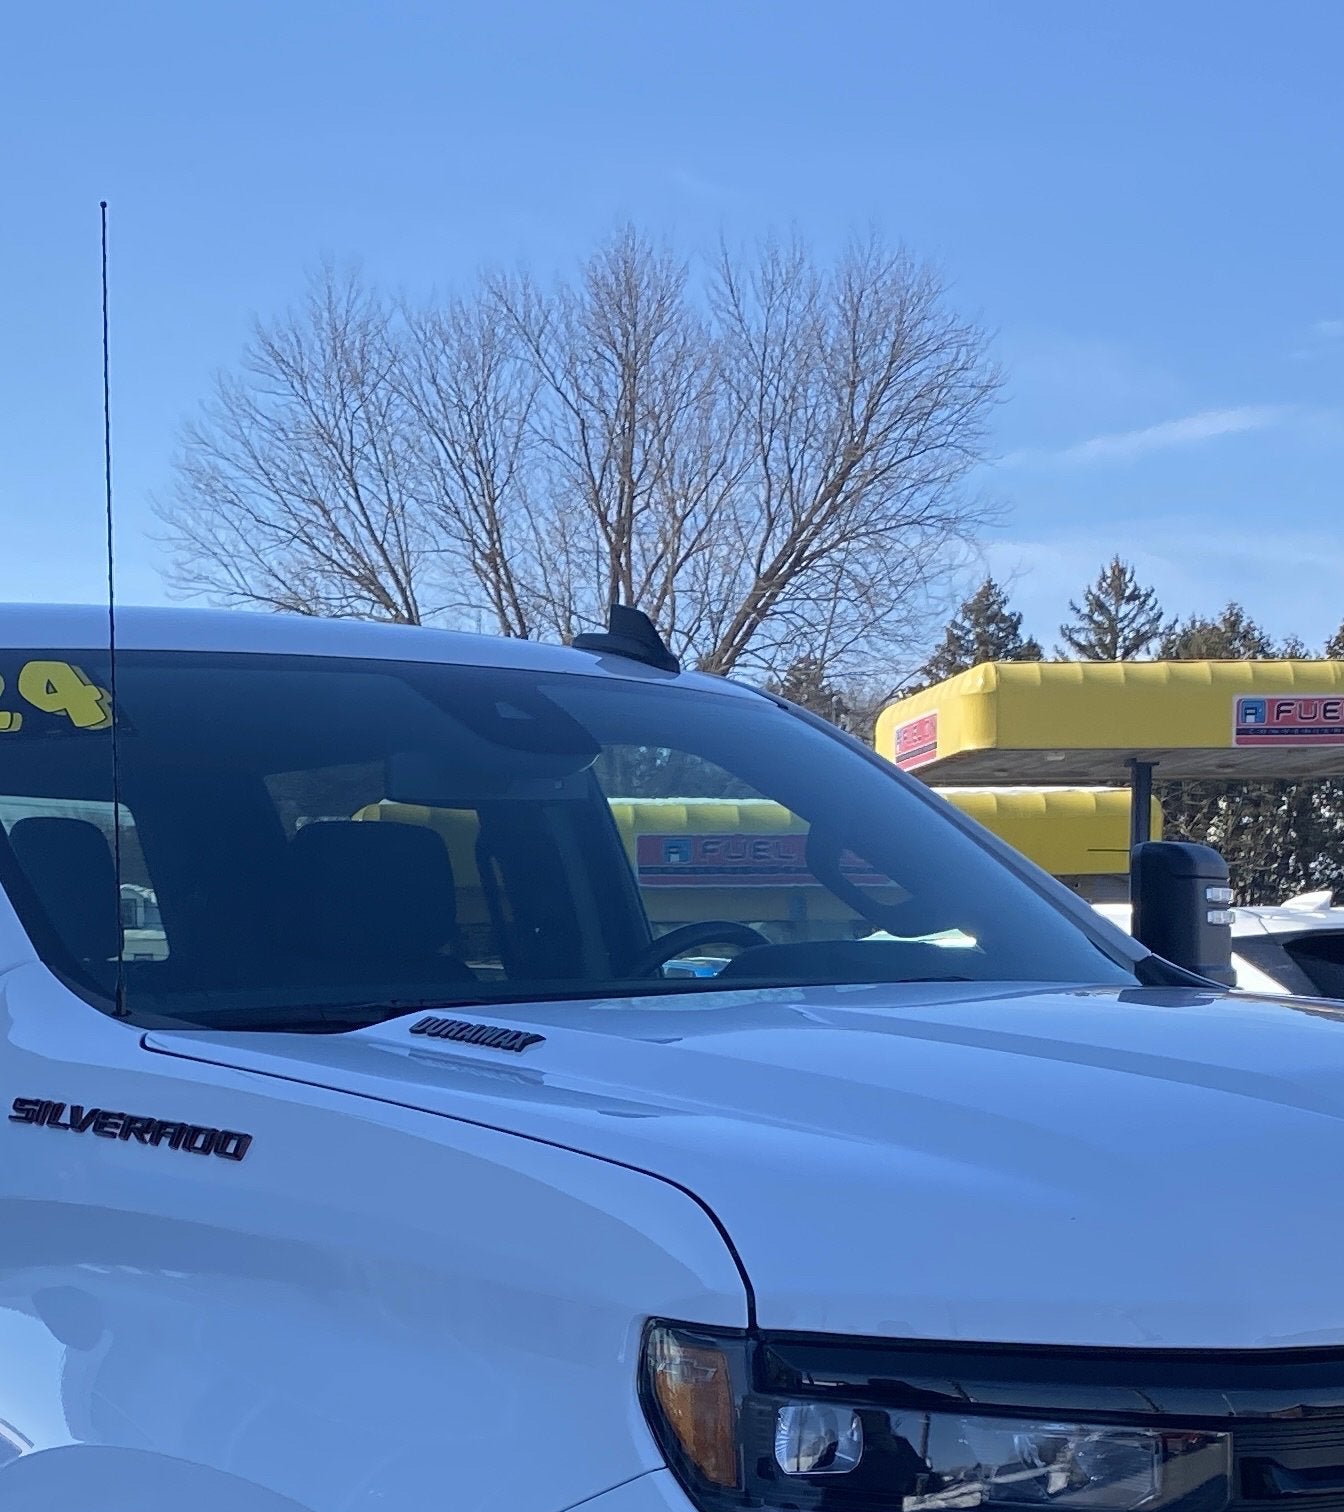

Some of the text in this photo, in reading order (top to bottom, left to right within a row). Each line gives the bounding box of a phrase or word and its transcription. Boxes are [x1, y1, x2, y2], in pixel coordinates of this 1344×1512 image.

[701, 840, 796, 861] FUEL
[409, 1015, 547, 1053] DURAMAX
[8, 1097, 253, 1161] SILVERADO
